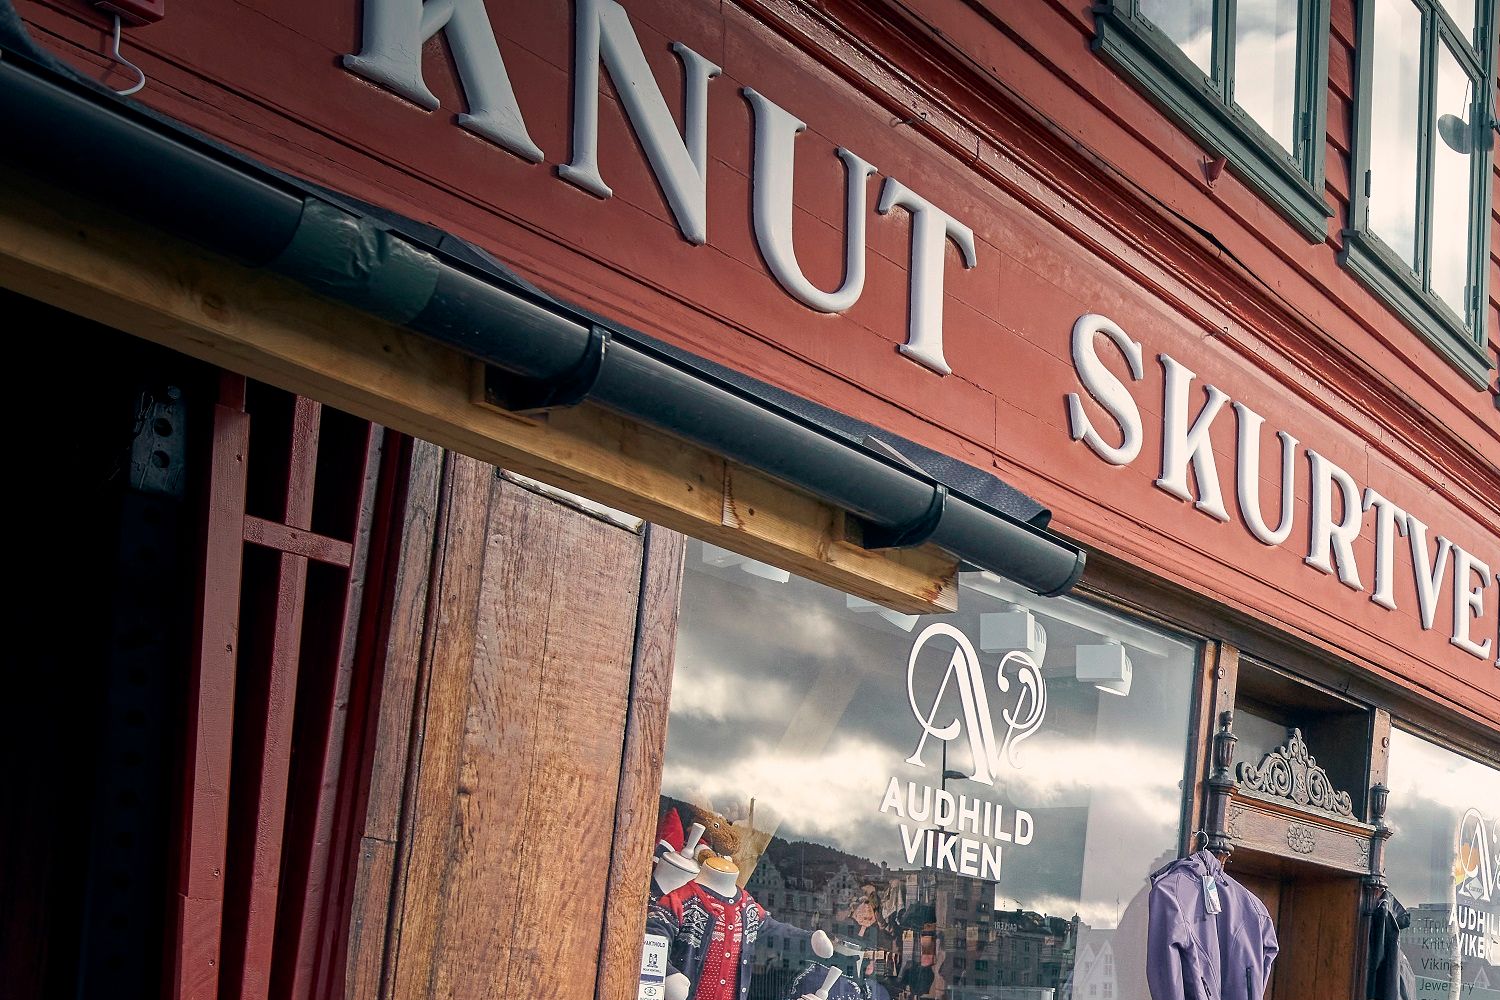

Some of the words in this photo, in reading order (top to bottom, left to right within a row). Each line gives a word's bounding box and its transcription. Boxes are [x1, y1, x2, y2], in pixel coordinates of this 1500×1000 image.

[879, 775, 1035, 846] AUDHILD
[899, 823, 1003, 882] VIKEN
[1456, 931, 1496, 965] VIKEN
